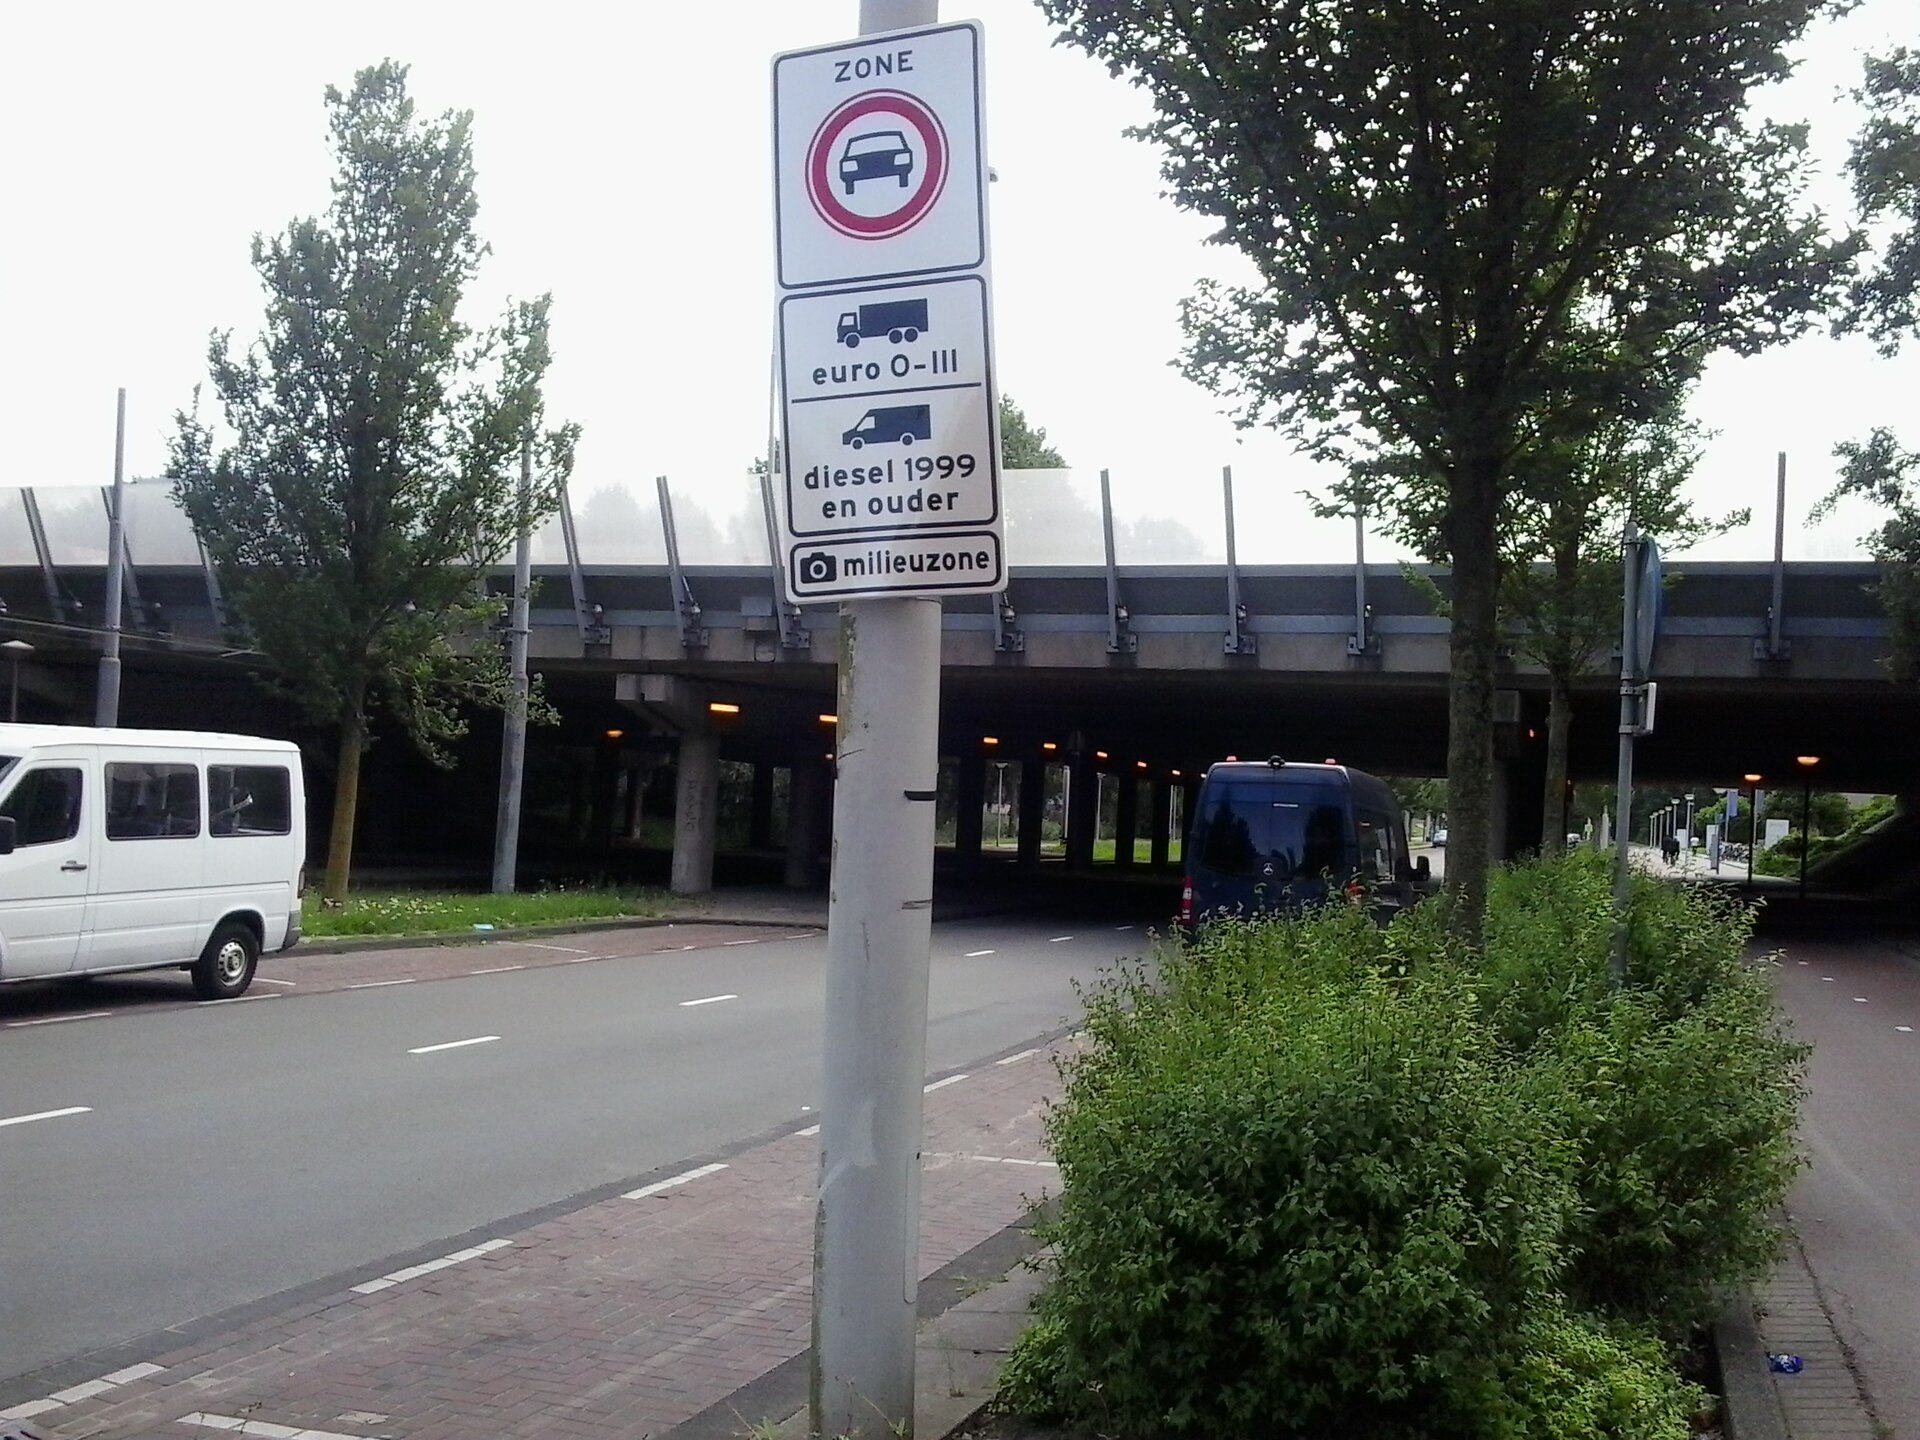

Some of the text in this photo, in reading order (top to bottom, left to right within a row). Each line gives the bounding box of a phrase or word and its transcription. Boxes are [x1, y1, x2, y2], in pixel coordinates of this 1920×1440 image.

[834, 50, 914, 83] ZONE
[812, 363, 880, 385] euro
[804, 454, 976, 489] diesel 1999
[822, 488, 959, 518] en ouder
[844, 550, 990, 577] milieuzone
